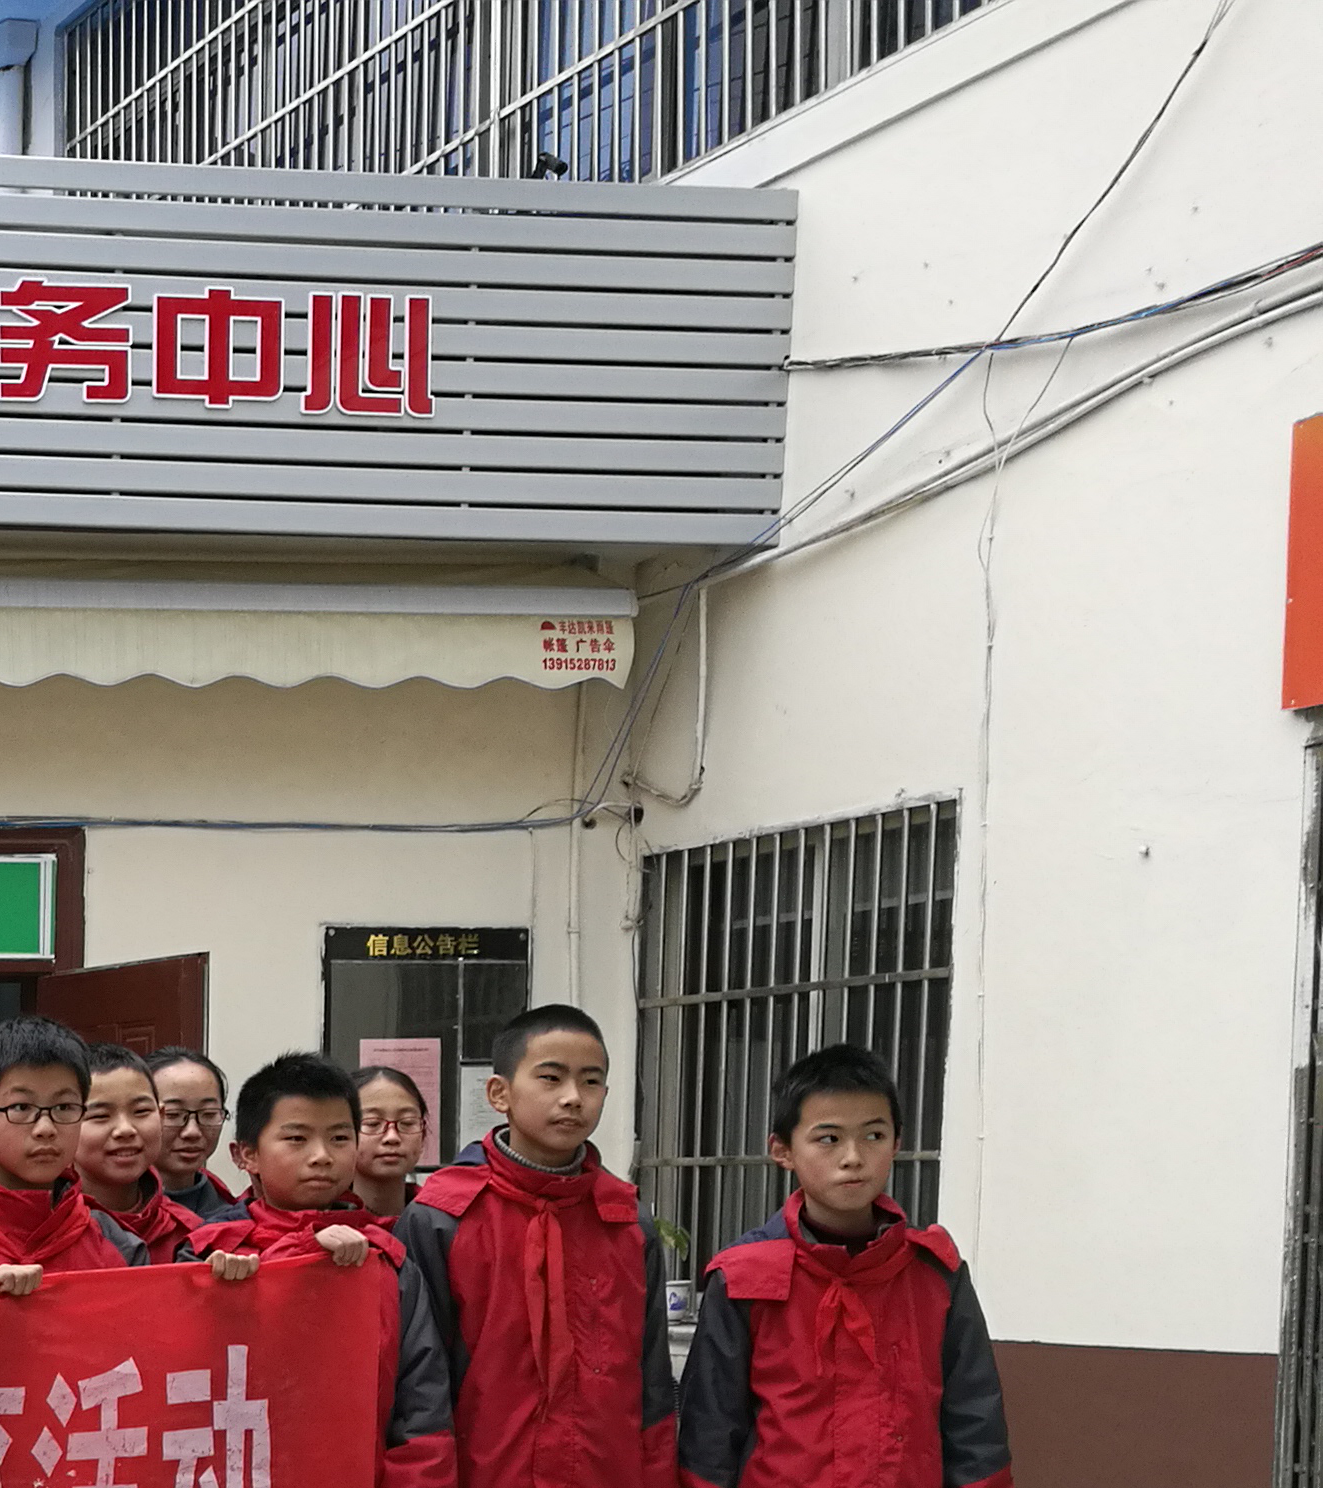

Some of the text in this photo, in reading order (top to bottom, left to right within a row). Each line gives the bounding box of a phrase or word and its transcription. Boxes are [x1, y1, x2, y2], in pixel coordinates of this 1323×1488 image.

[542, 658, 616, 672] 13915287813
[366, 933, 480, 957] 信息公告栏
